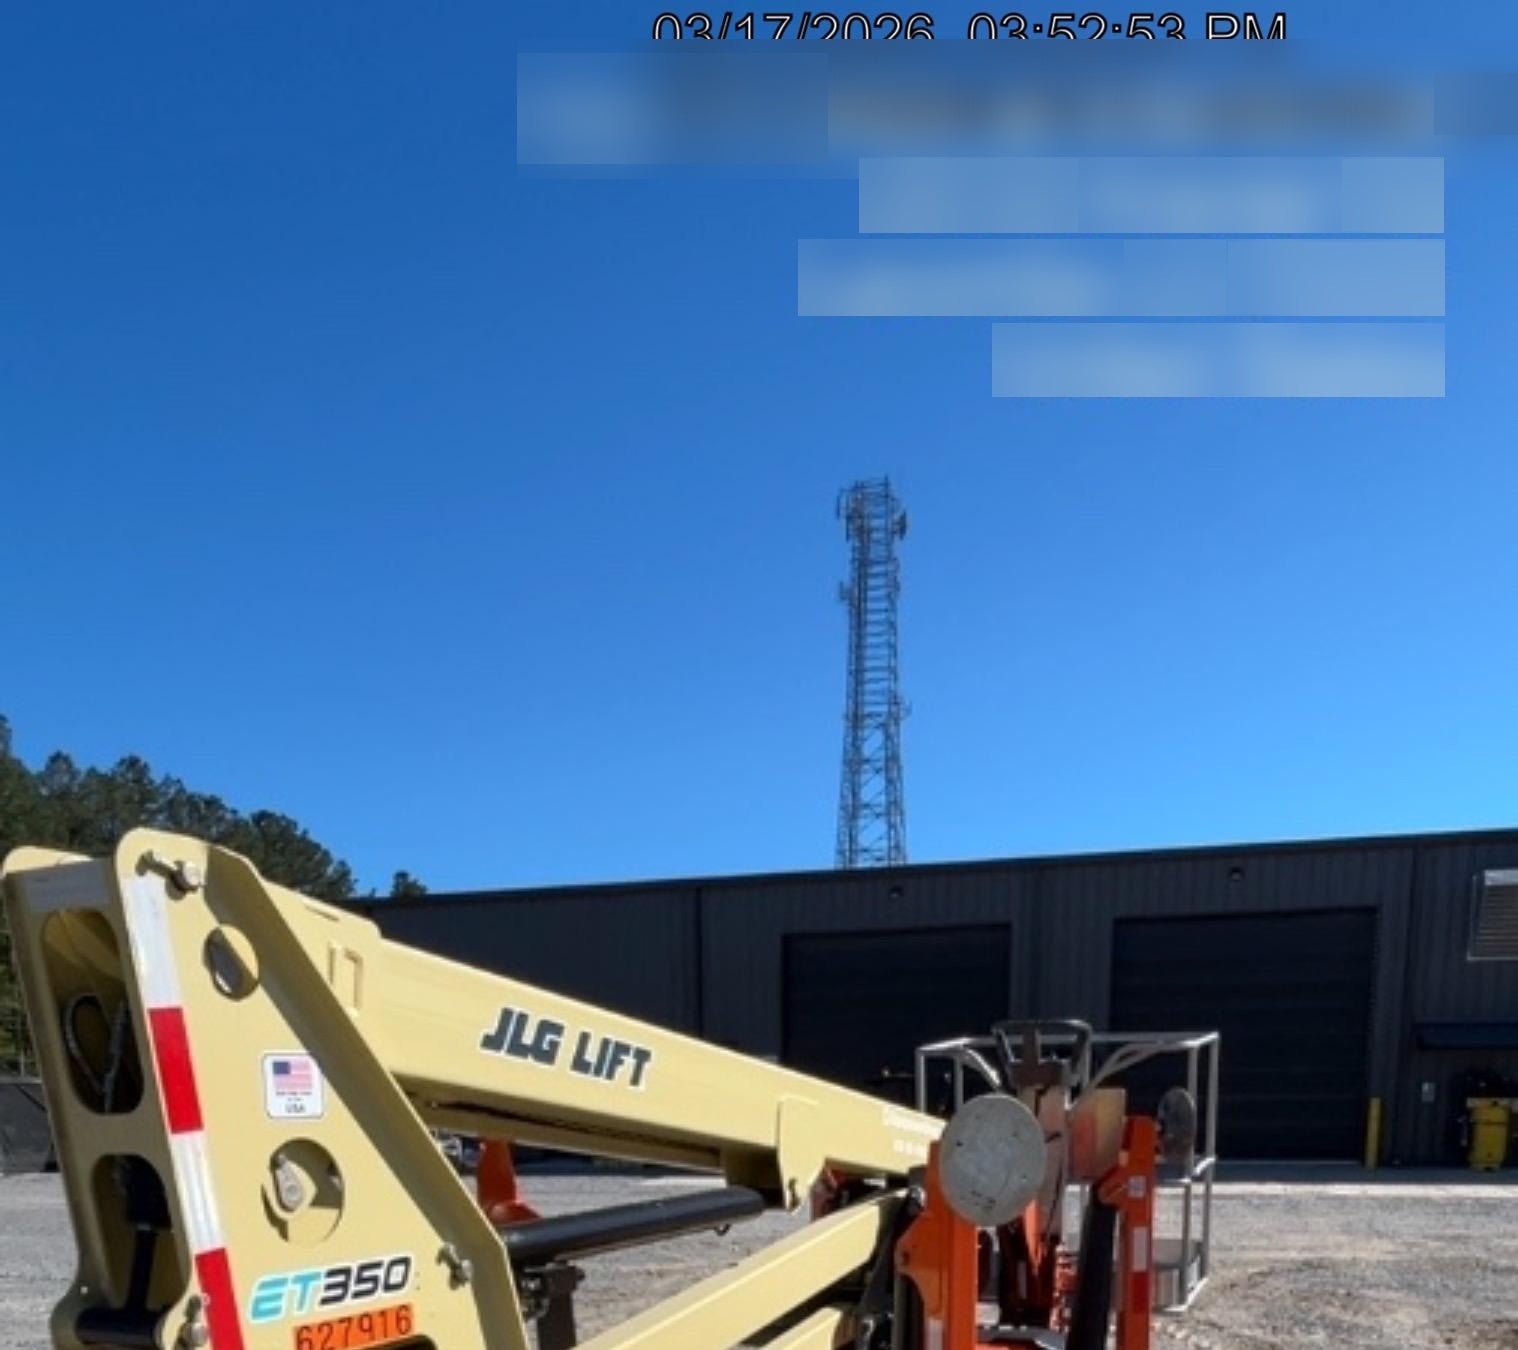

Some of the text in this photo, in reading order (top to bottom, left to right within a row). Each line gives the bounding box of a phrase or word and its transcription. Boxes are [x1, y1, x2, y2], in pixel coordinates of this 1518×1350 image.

[480, 1006, 652, 1087] JLG LIFT
[250, 1255, 412, 1321] ET350
